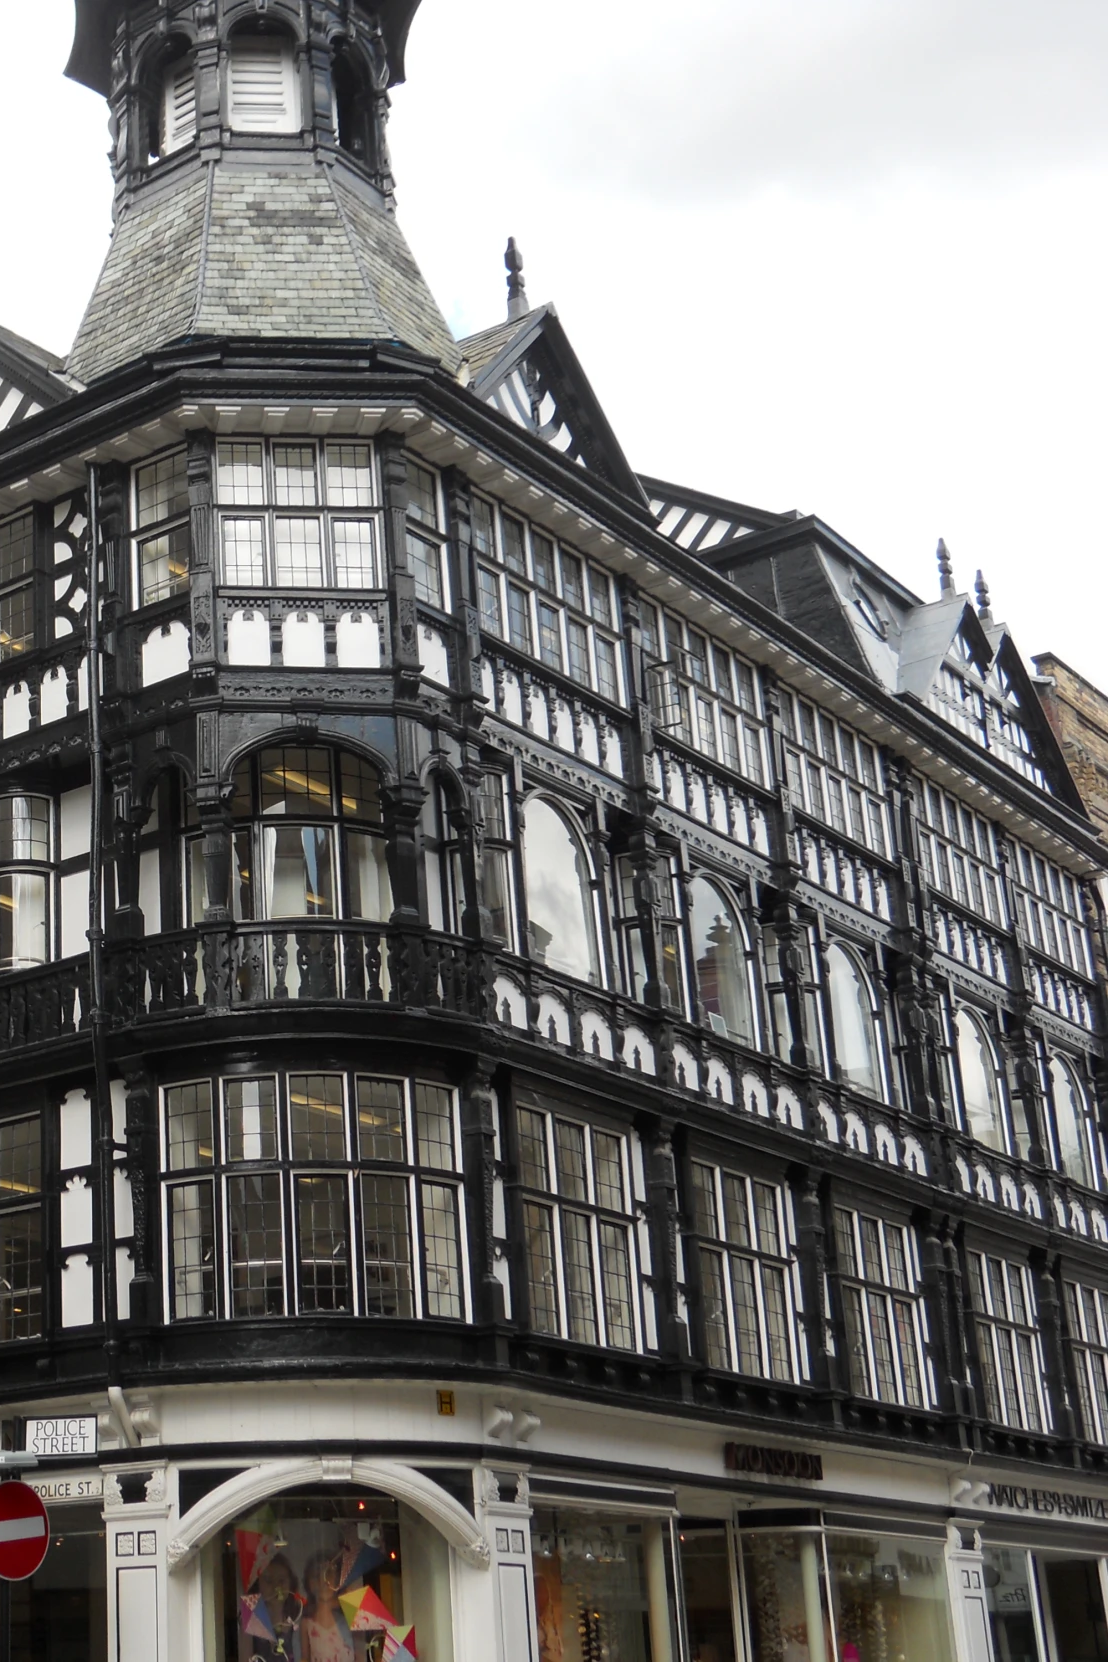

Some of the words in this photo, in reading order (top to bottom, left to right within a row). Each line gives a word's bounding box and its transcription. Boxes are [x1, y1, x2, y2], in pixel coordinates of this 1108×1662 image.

[35, 1420, 86, 1437] POLICE
[32, 1436, 89, 1453] STREET
[725, 1442, 823, 1480] MONSOON
[34, 1483, 71, 1498] POLICE
[77, 1481, 94, 1495] ST.
[988, 1483, 1054, 1513] WATCHES
